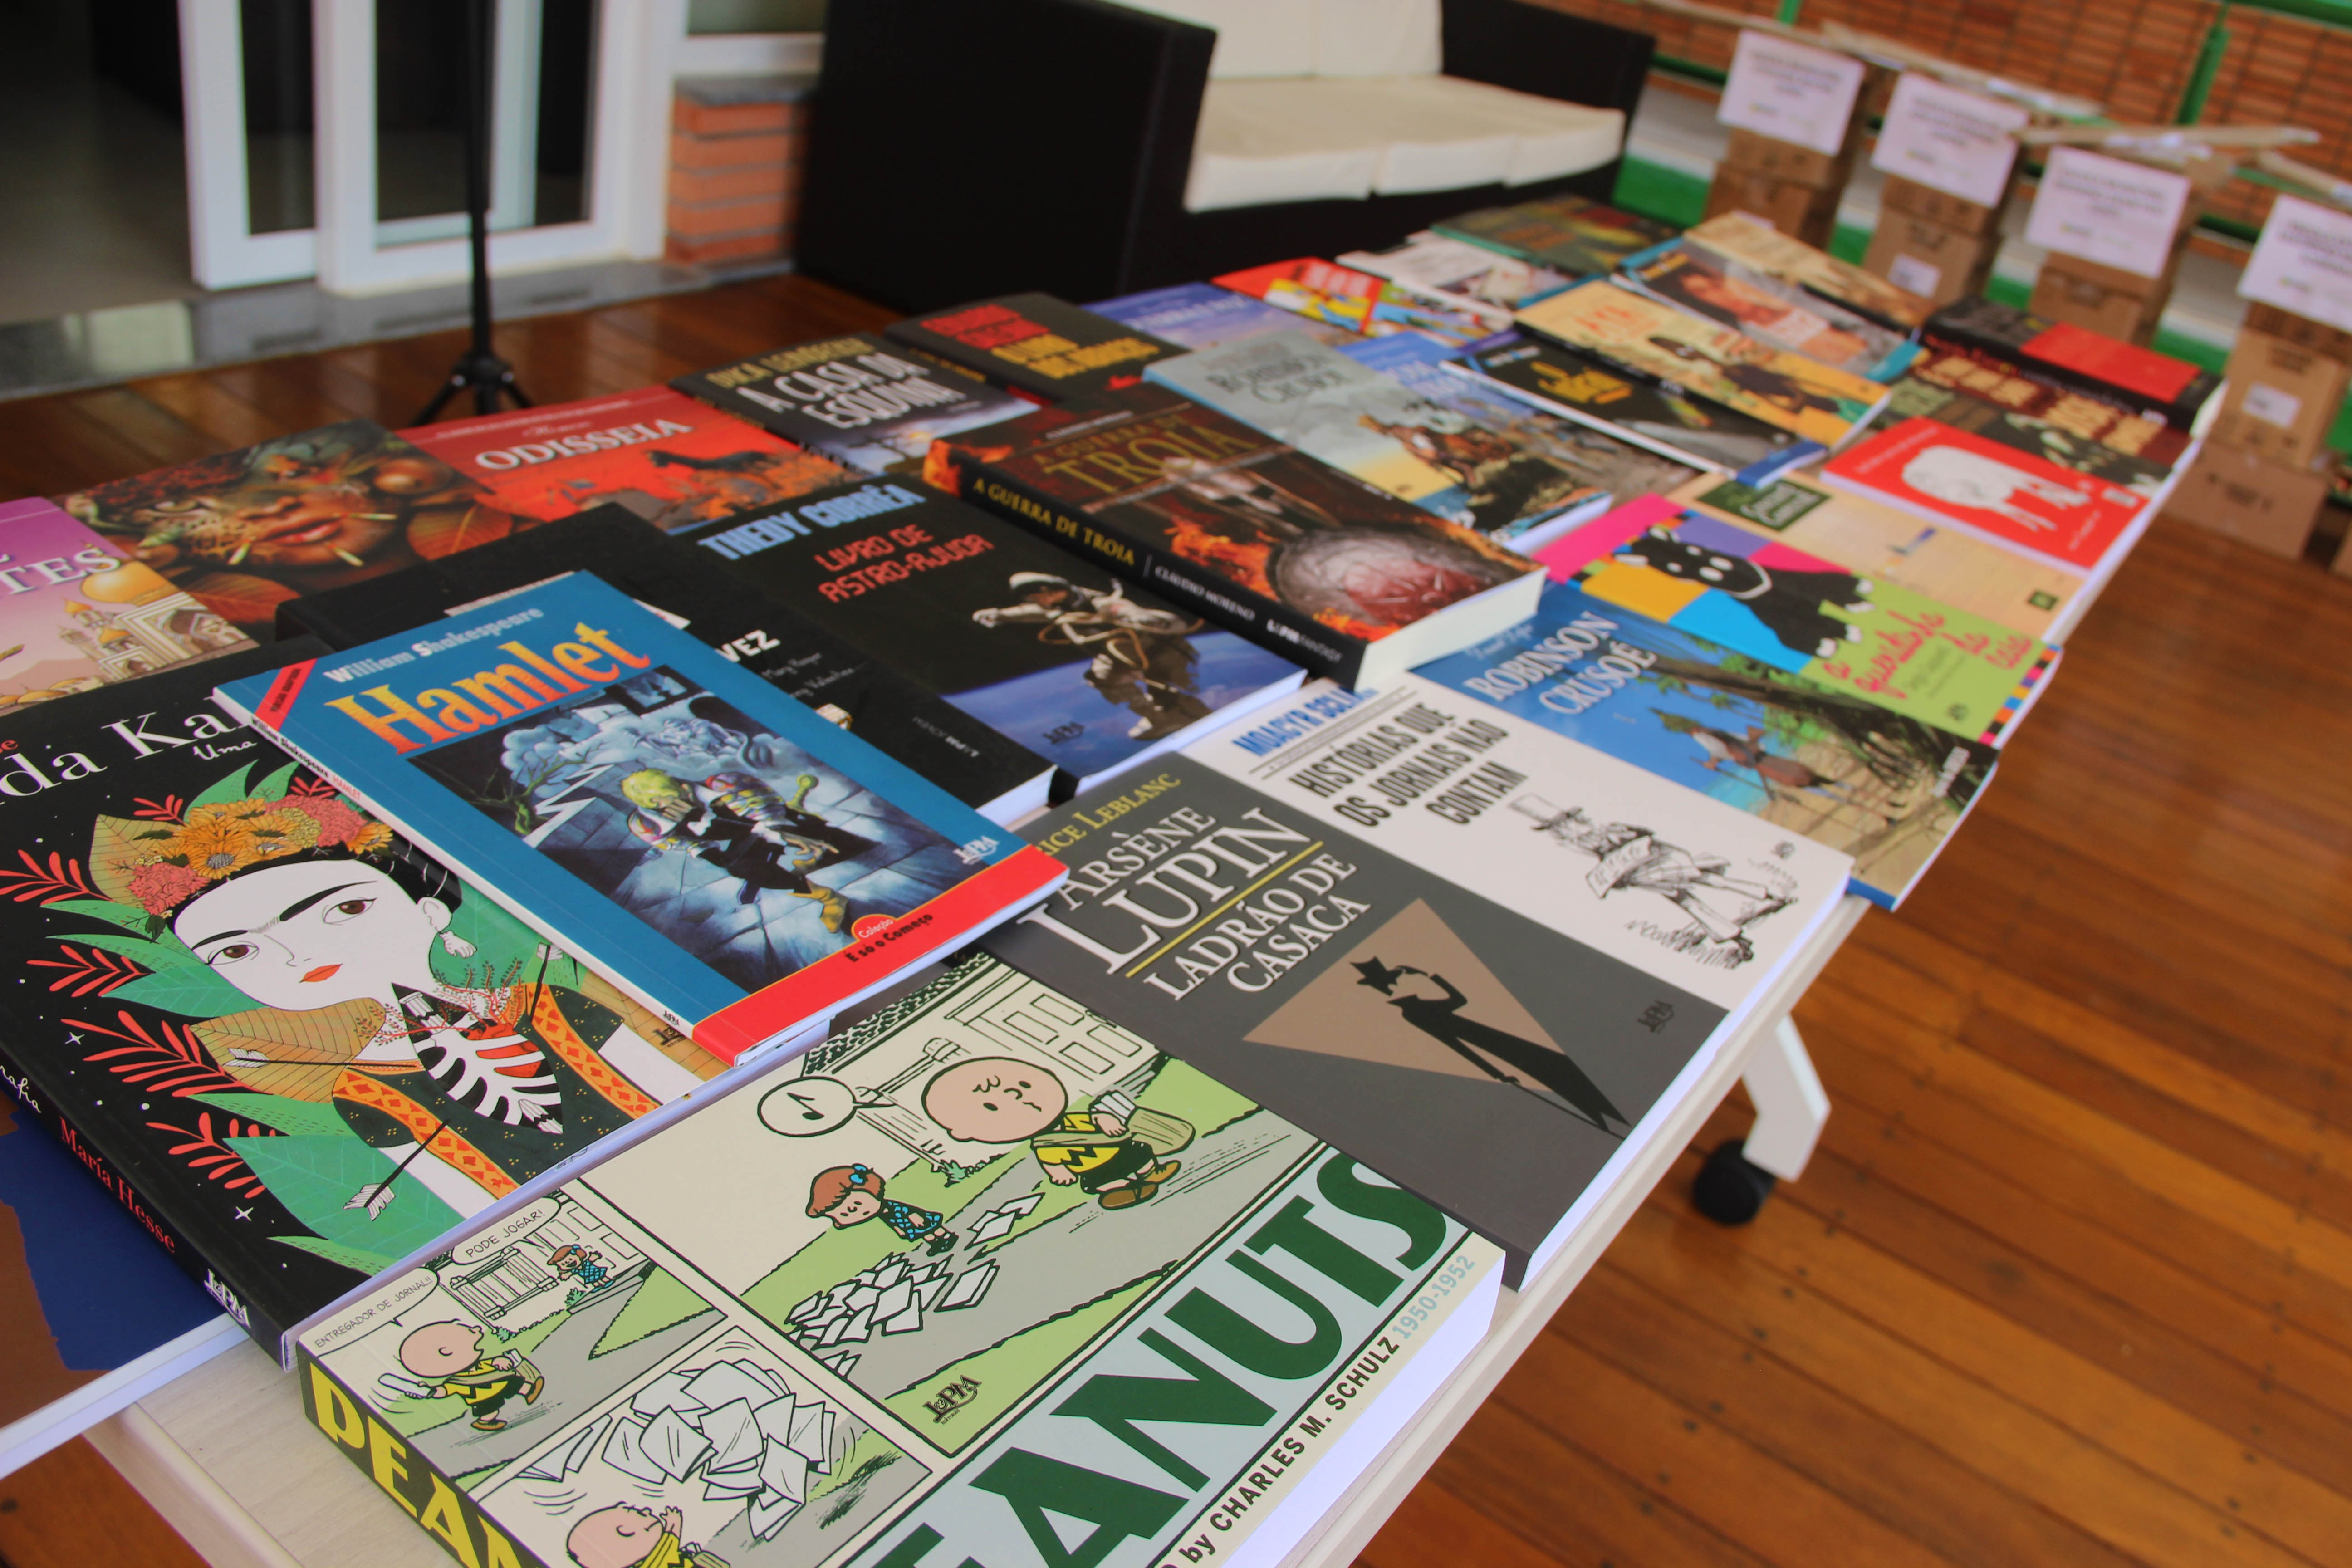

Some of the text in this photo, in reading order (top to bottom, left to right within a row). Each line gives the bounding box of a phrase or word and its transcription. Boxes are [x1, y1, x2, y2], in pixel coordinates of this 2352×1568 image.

[736, 386, 796, 413] A
[774, 362, 885, 401] CASA
[802, 377, 967, 428] ESQUINA
[475, 419, 694, 470] ODISSEIA
[1044, 425, 1259, 493] TROIA
[697, 484, 926, 560] THEDY CORRÊA
[814, 524, 934, 572] LIVRO DE
[973, 478, 985, 494] A
[987, 483, 1052, 526] GUERRA
[1056, 515, 1079, 539] DE
[1083, 527, 1135, 566] TROIA
[818, 534, 995, 603] ASTRO-AJUDA
[322, 608, 544, 683] William Shakespeare
[715, 629, 781, 662] VEZ
[1463, 610, 1620, 701] ROBINSON
[324, 622, 651, 755] Hamlet
[0, 700, 249, 801] da Ka
[194, 740, 257, 760] Uma
[1288, 724, 1419, 799] HISTÓRIAS
[1393, 703, 1456, 735] QUE
[1333, 796, 1392, 827] OS
[1368, 742, 1473, 807] JORNAIS
[1072, 773, 1181, 830] LEBLANC
[1425, 760, 1528, 825] CONTAM
[1016, 807, 1313, 975] LUPIN
[1057, 806, 1216, 911] ARSÈNE
[858, 944, 875, 956] só
[883, 914, 932, 941] Começo
[1143, 853, 1358, 1001] LADRÃO DE
[1226, 895, 1372, 993] CASACA
[59, 1116, 113, 1187] María
[118, 1176, 175, 1254] Hesse
[466, 1209, 545, 1259] PODE JOGAR!
[315, 1275, 433, 1348] ENTREGADOR DE JORNAL!!
[922, 1374, 982, 1423] L&PM
[1178, 1255, 1475, 1563] by CHARLES M. SCHULZ 1950-1952
